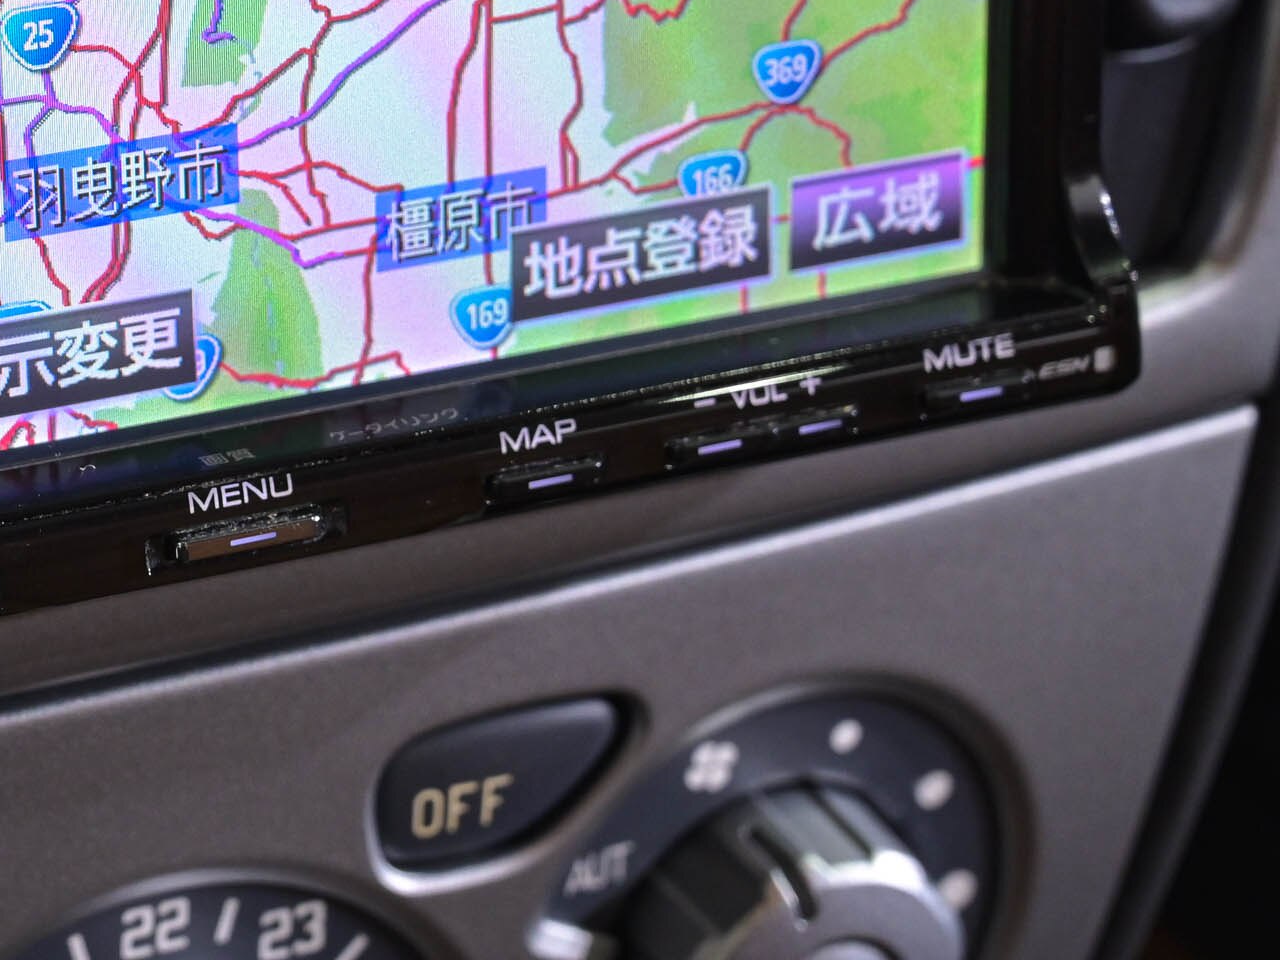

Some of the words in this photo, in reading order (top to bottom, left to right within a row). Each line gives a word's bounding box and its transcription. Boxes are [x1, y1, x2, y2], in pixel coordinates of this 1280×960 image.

[22, 17, 56, 53] 25
[763, 52, 809, 88] 369
[12, 138, 226, 231] 羽曳野市
[692, 162, 734, 198] 166
[384, 179, 536, 263] 橿原市
[811, 173, 942, 252] 広域
[522, 201, 756, 301] 地点登録
[465, 297, 509, 331] 169
[923, 333, 1016, 373] MUTE
[731, 384, 789, 410] VOL
[499, 418, 578, 454] MAP
[187, 473, 294, 515] MENU
[412, 773, 516, 840] OFF
[121, 898, 190, 957] 22
[257, 900, 328, 959] 23
